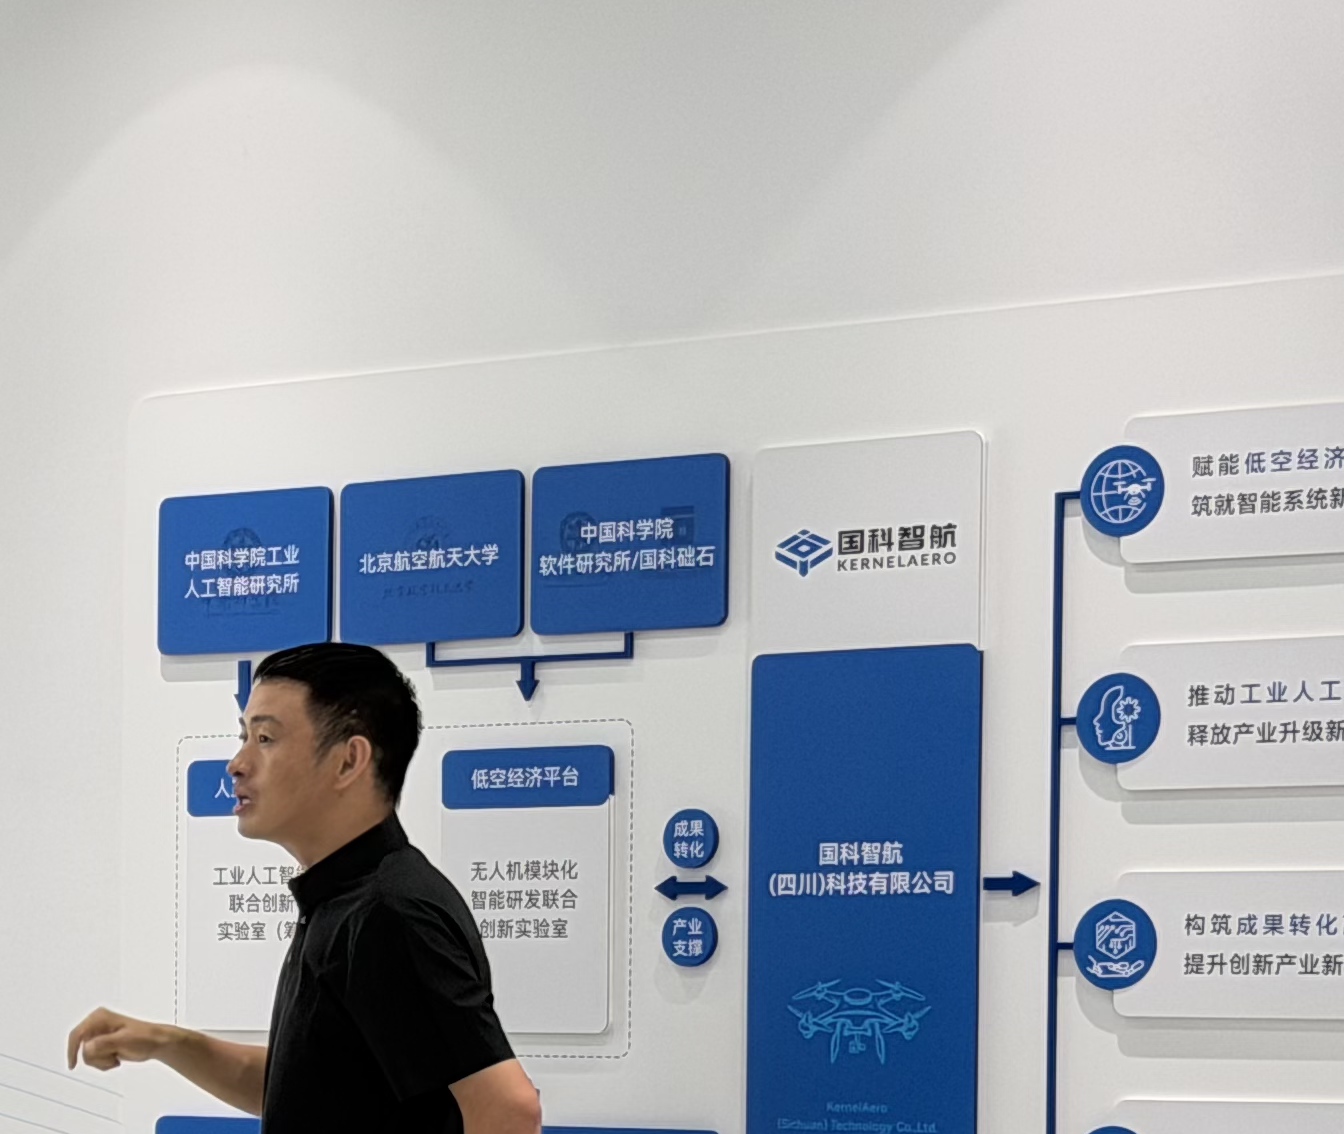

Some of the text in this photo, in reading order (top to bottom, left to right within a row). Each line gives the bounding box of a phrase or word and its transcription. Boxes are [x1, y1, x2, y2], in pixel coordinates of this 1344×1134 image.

[580, 517, 673, 544] 中国科学院
[837, 523, 957, 555] 国科智航
[184, 544, 300, 572] 中国科学院工业
[359, 544, 499, 574] 北京航空航天大学
[539, 545, 716, 576] 软件研究所/国科础石
[837, 551, 957, 571] KERNELAERO
[184, 573, 299, 599] 人工智能研究所
[1187, 680, 1342, 707] 推动工业人工
[471, 764, 579, 790] 低空经济平台
[673, 820, 705, 839] 成果
[673, 840, 705, 859] 转化
[818, 841, 903, 865] 国科智航
[470, 859, 579, 881] 无人机模块化
[769, 870, 954, 897] (四川)科技有限公司
[229, 893, 294, 913] 联合创新
[470, 888, 579, 910] 智能研发联合
[480, 918, 569, 939] 创新实验室
[672, 917, 703, 936] 产业
[1184, 913, 1344, 937] 构筑成果转化
[672, 937, 704, 958] 支撑
